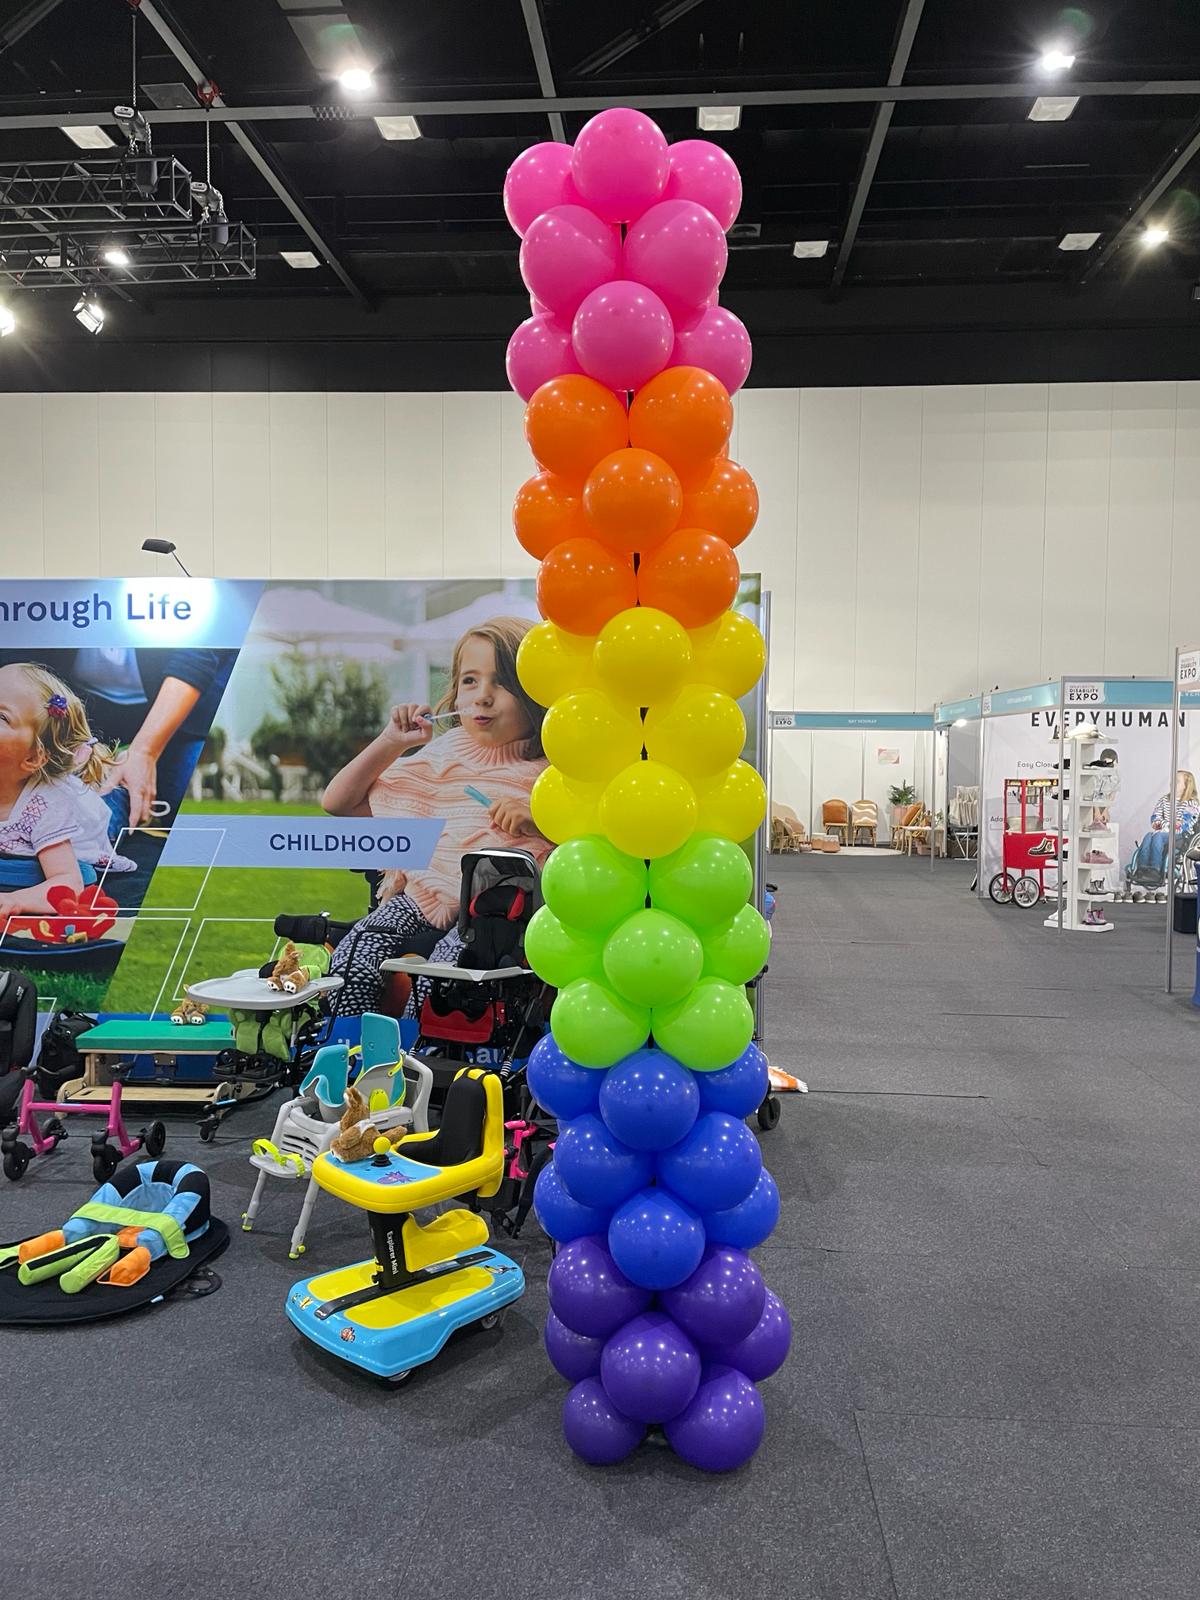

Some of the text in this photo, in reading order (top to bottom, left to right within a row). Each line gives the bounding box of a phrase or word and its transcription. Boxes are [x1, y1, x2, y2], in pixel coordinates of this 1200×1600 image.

[127, 592, 192, 620] Life
[1180, 667, 1197, 680] EXPO
[1069, 693, 1098, 701] EXPO
[1017, 761, 1034, 769] Easy
[269, 833, 411, 853] CHILDHOOD
[386, 1230, 400, 1275] Explorer Mini
